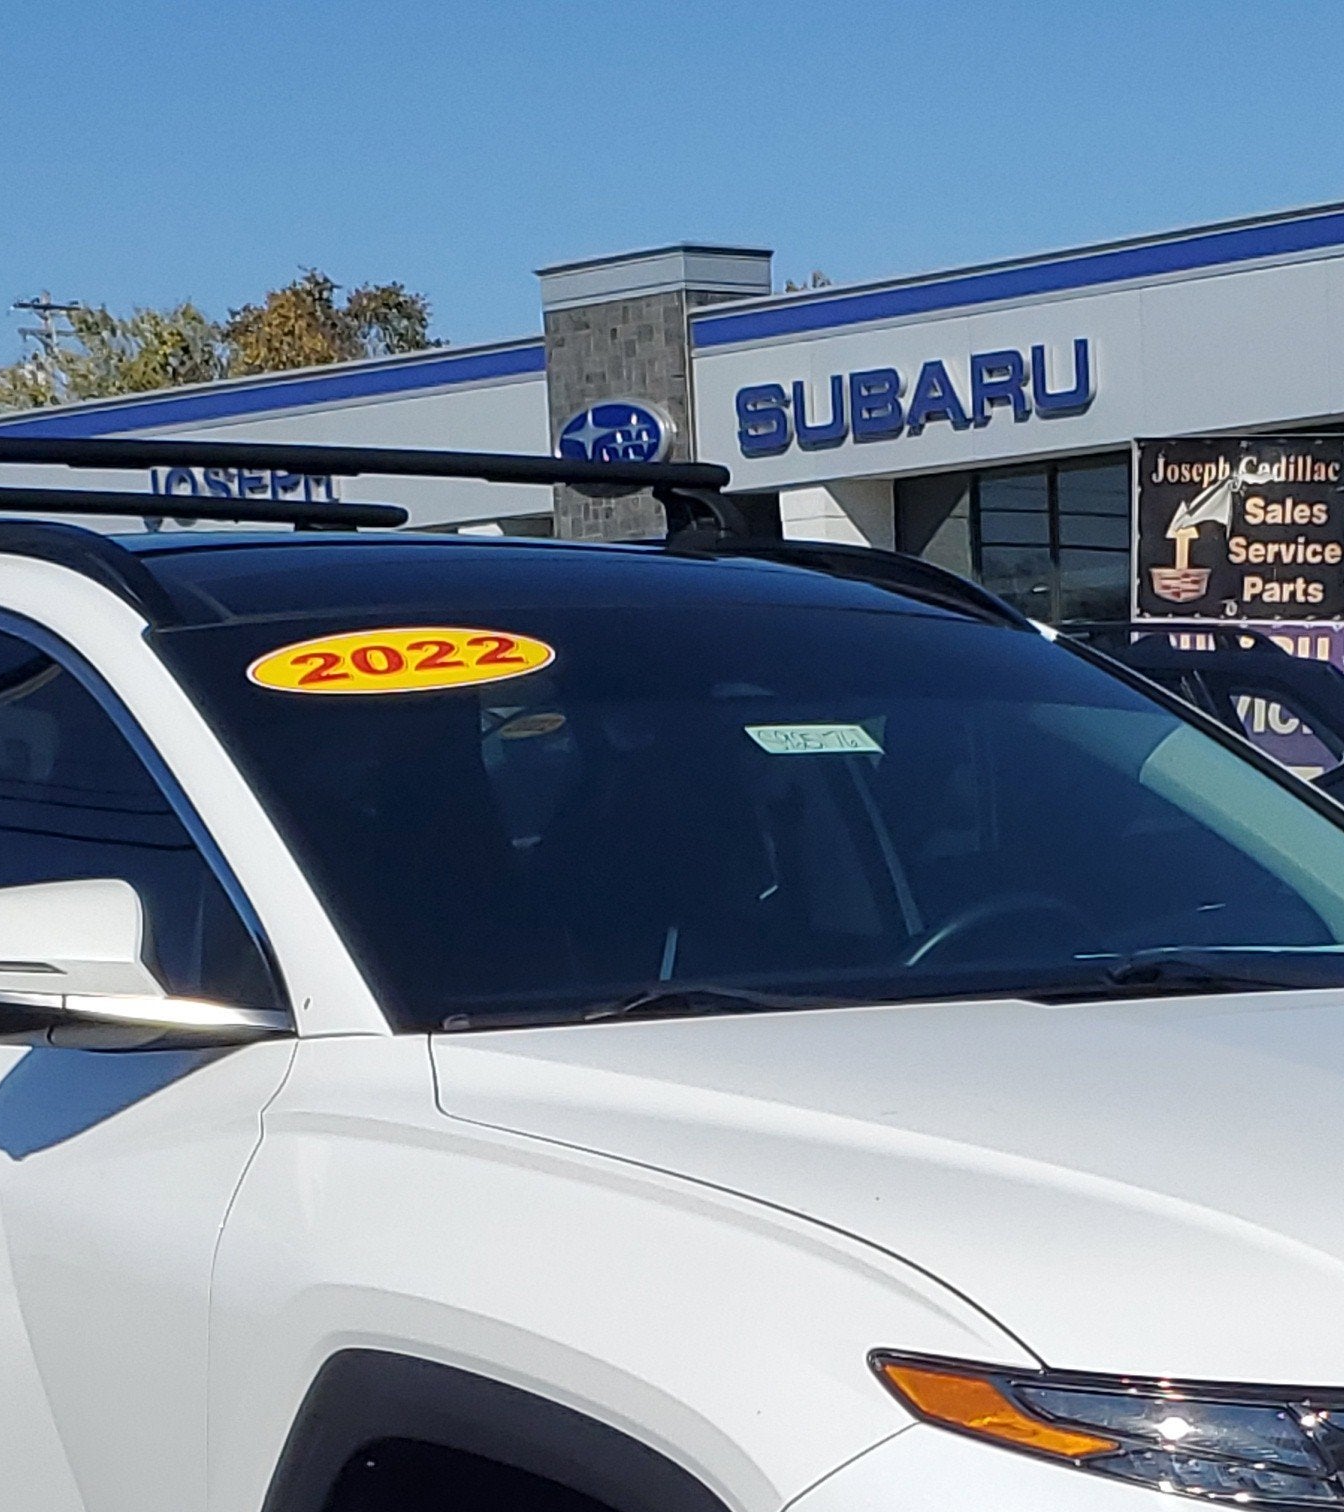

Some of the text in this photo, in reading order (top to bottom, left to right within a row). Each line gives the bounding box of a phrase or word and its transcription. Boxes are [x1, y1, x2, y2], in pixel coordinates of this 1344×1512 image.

[736, 338, 1097, 459] SUBARU
[1151, 455, 1231, 488] Joseph
[1244, 497, 1329, 526] Sales
[1228, 535, 1342, 564] Service
[1242, 575, 1324, 603] Parts
[290, 636, 525, 686] 2022
